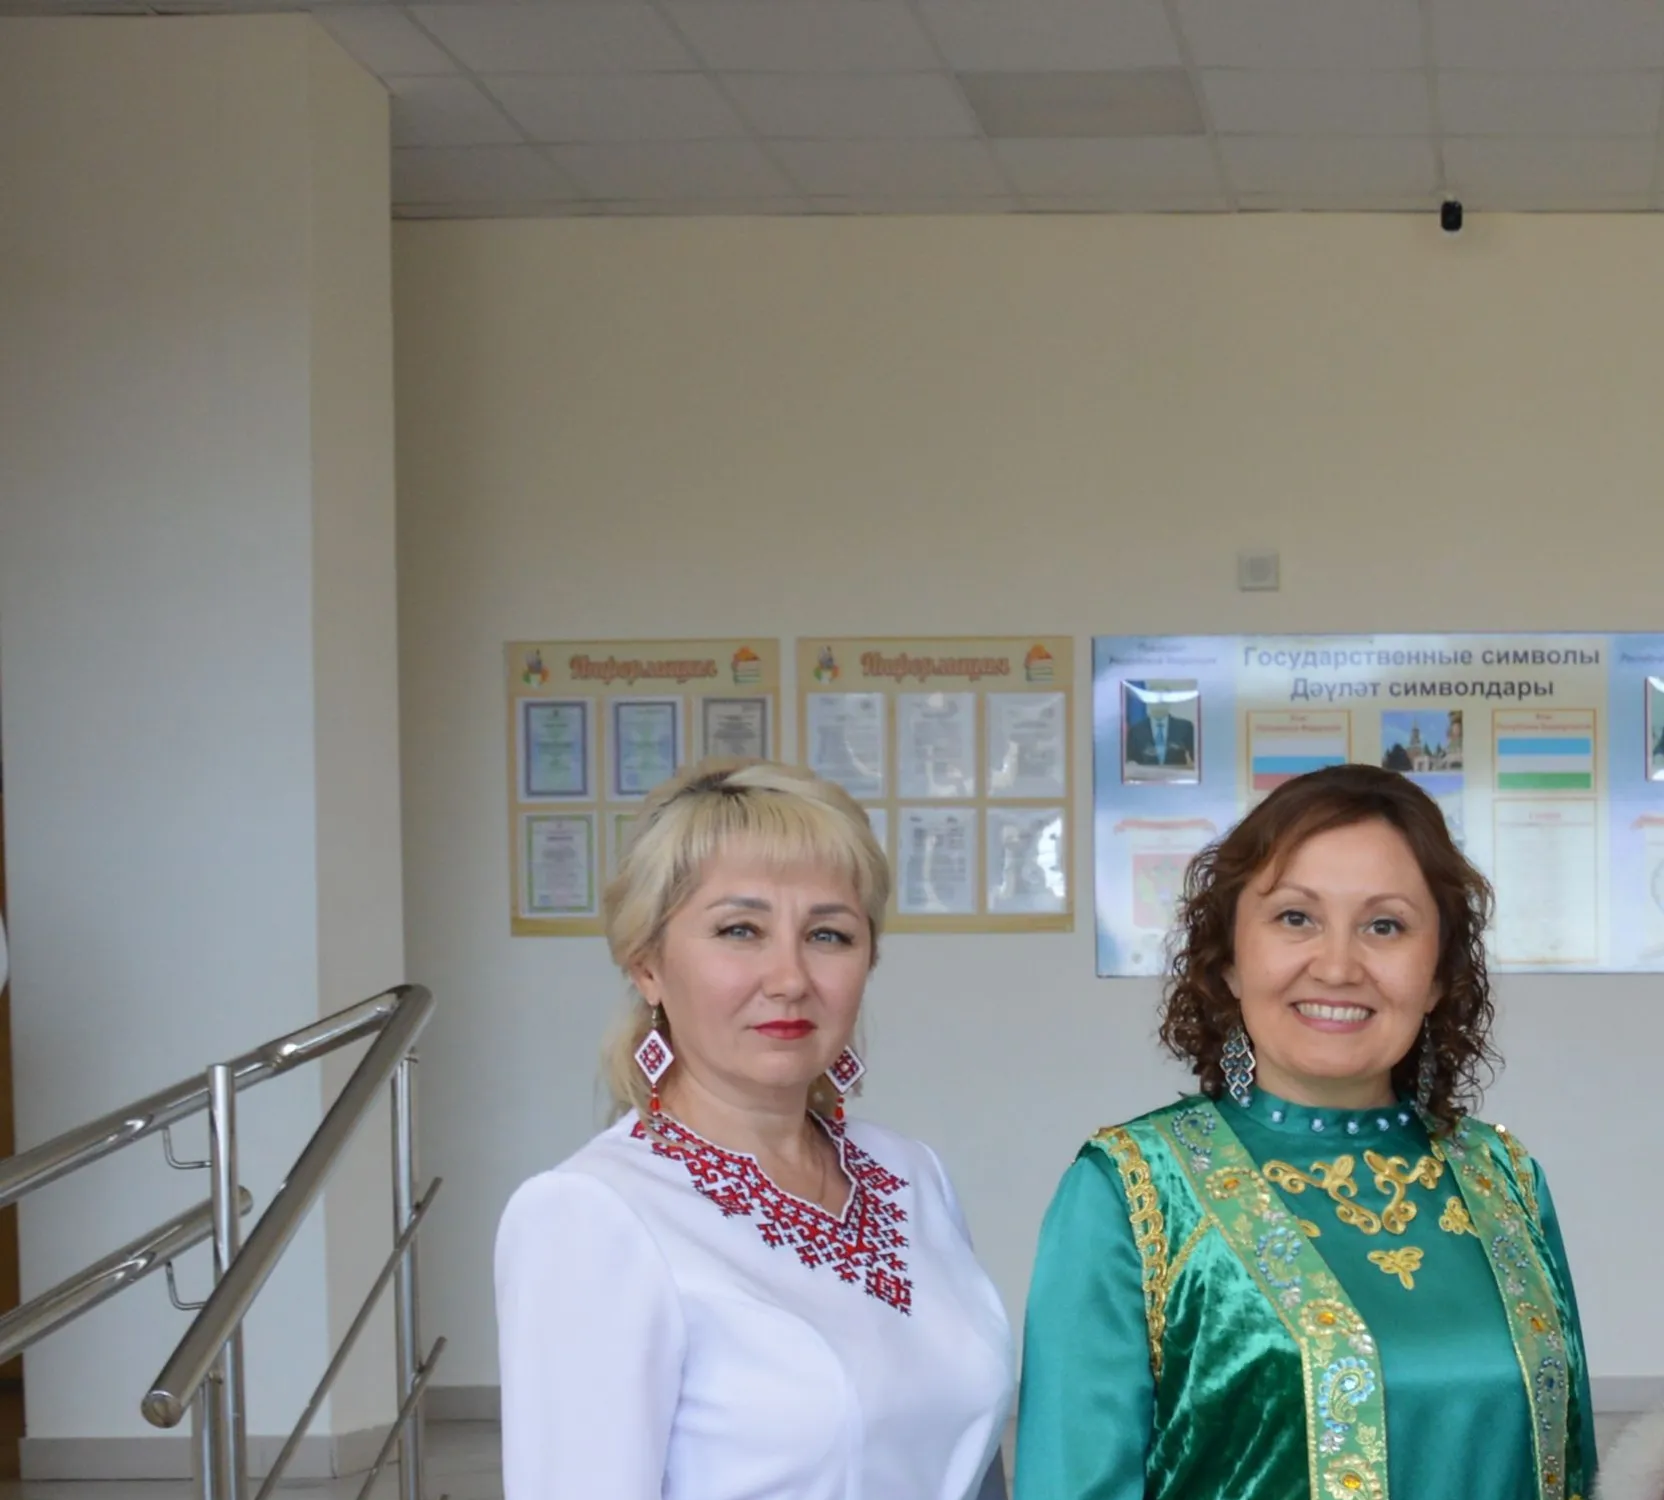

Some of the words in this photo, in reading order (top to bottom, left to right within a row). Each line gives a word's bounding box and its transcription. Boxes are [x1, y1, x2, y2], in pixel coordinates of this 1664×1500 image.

[569, 654, 718, 686] Информация
[860, 651, 1011, 684] Информация
[1243, 646, 1473, 670] Государственные
[1481, 648, 1600, 665] символы
[1290, 678, 1381, 702] Дәүләт
[1388, 680, 1554, 702] символдары
